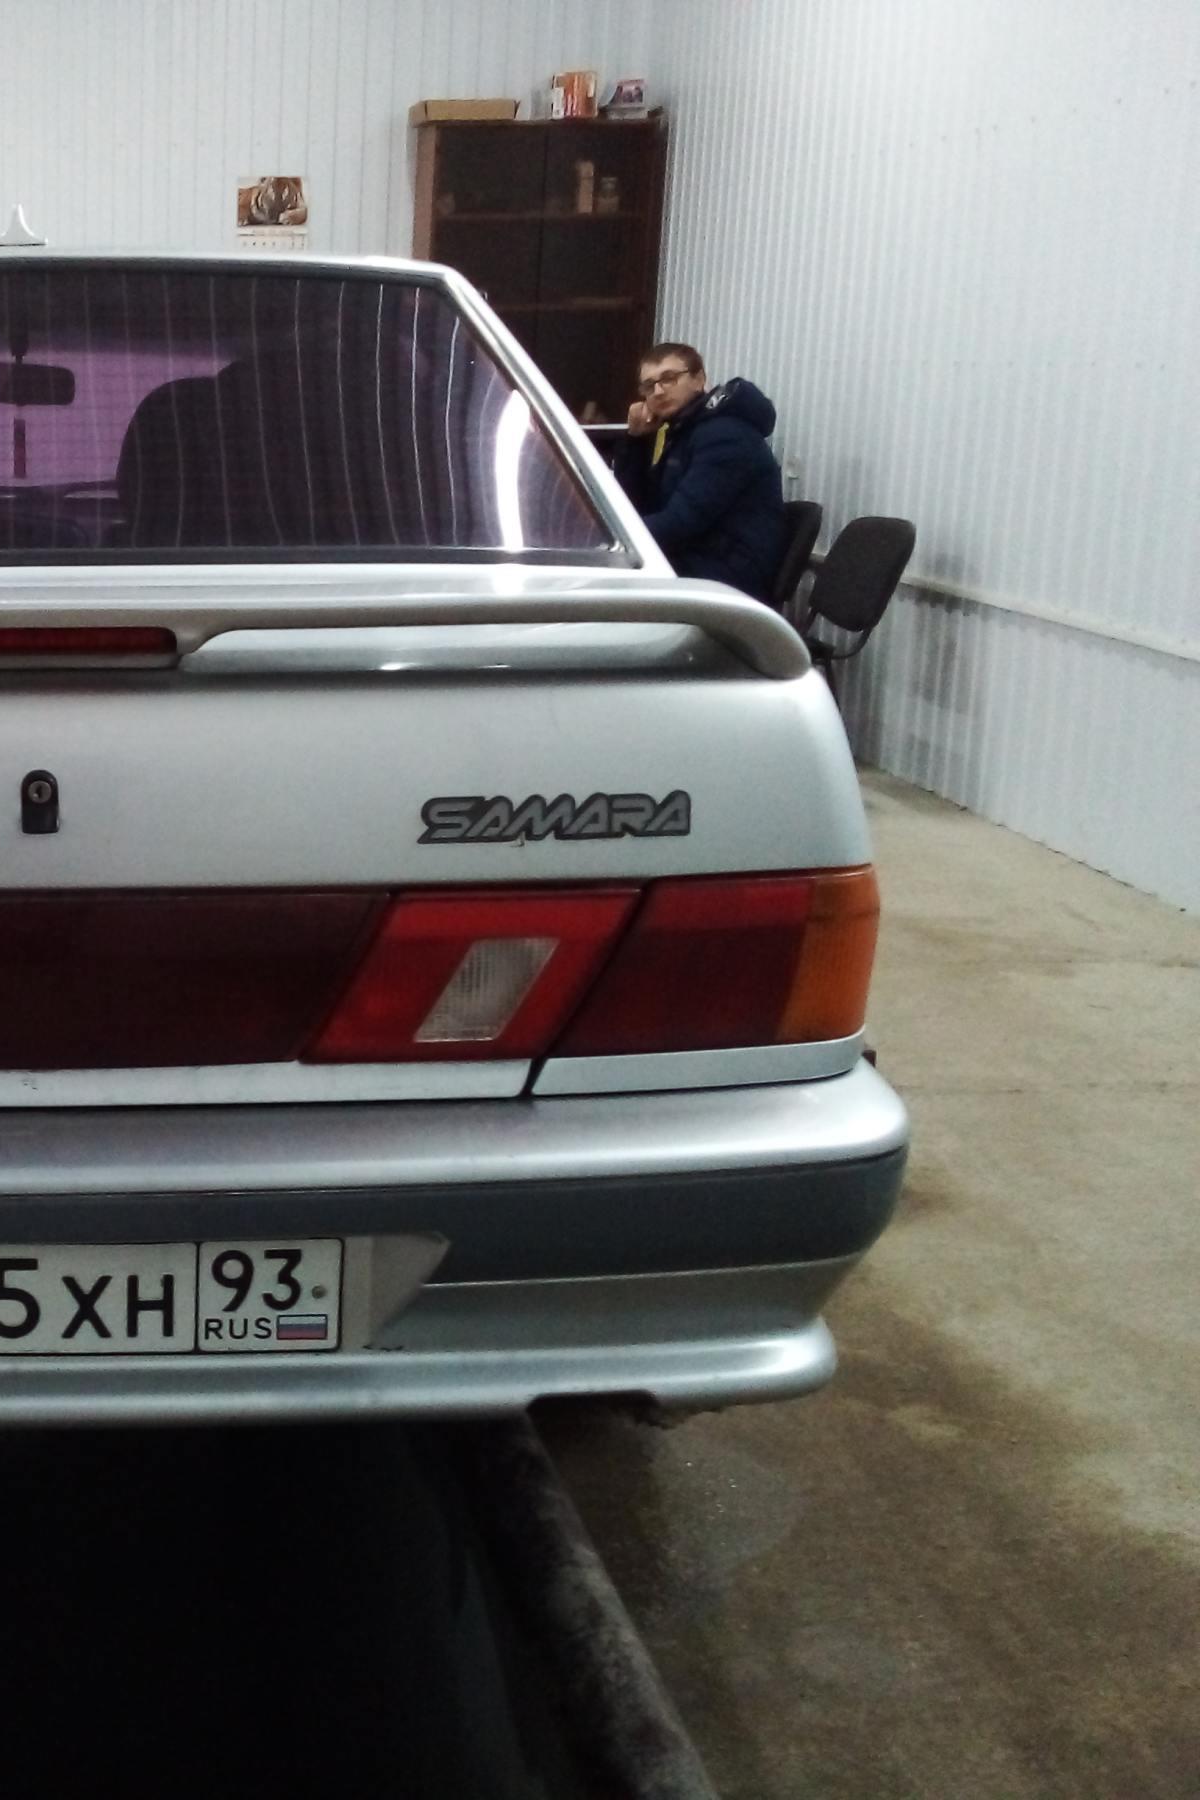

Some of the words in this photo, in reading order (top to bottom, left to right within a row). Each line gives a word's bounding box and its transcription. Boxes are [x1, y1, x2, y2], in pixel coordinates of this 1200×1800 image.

[417, 790, 691, 844] SAMARA
[211, 1248, 304, 1312] 93
[204, 1317, 272, 1340] RUS
